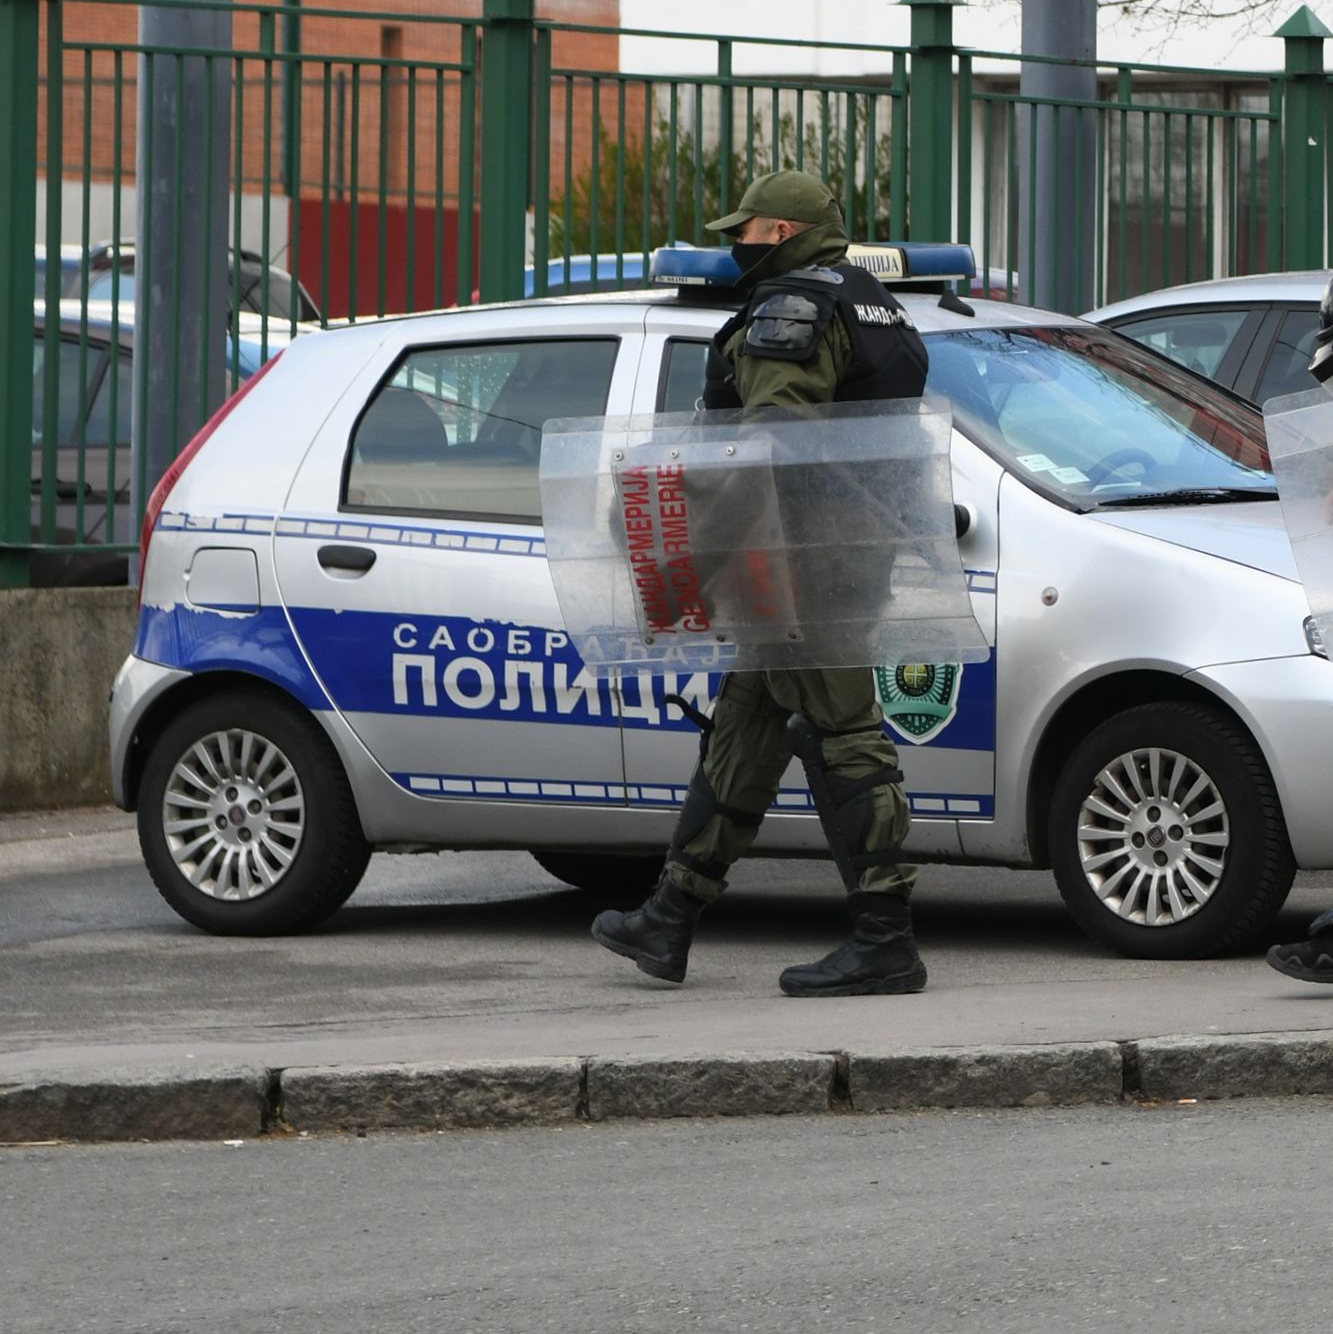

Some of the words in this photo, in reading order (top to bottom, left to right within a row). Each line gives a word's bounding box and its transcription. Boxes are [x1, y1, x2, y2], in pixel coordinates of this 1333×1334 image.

[850, 254, 900, 275] ЛИЦИЈА
[622, 465, 678, 635] ЖАНДАРМЕРИЈА
[657, 463, 711, 633] GENDARMERIE
[392, 652, 715, 725] ПОЛИЦИ
